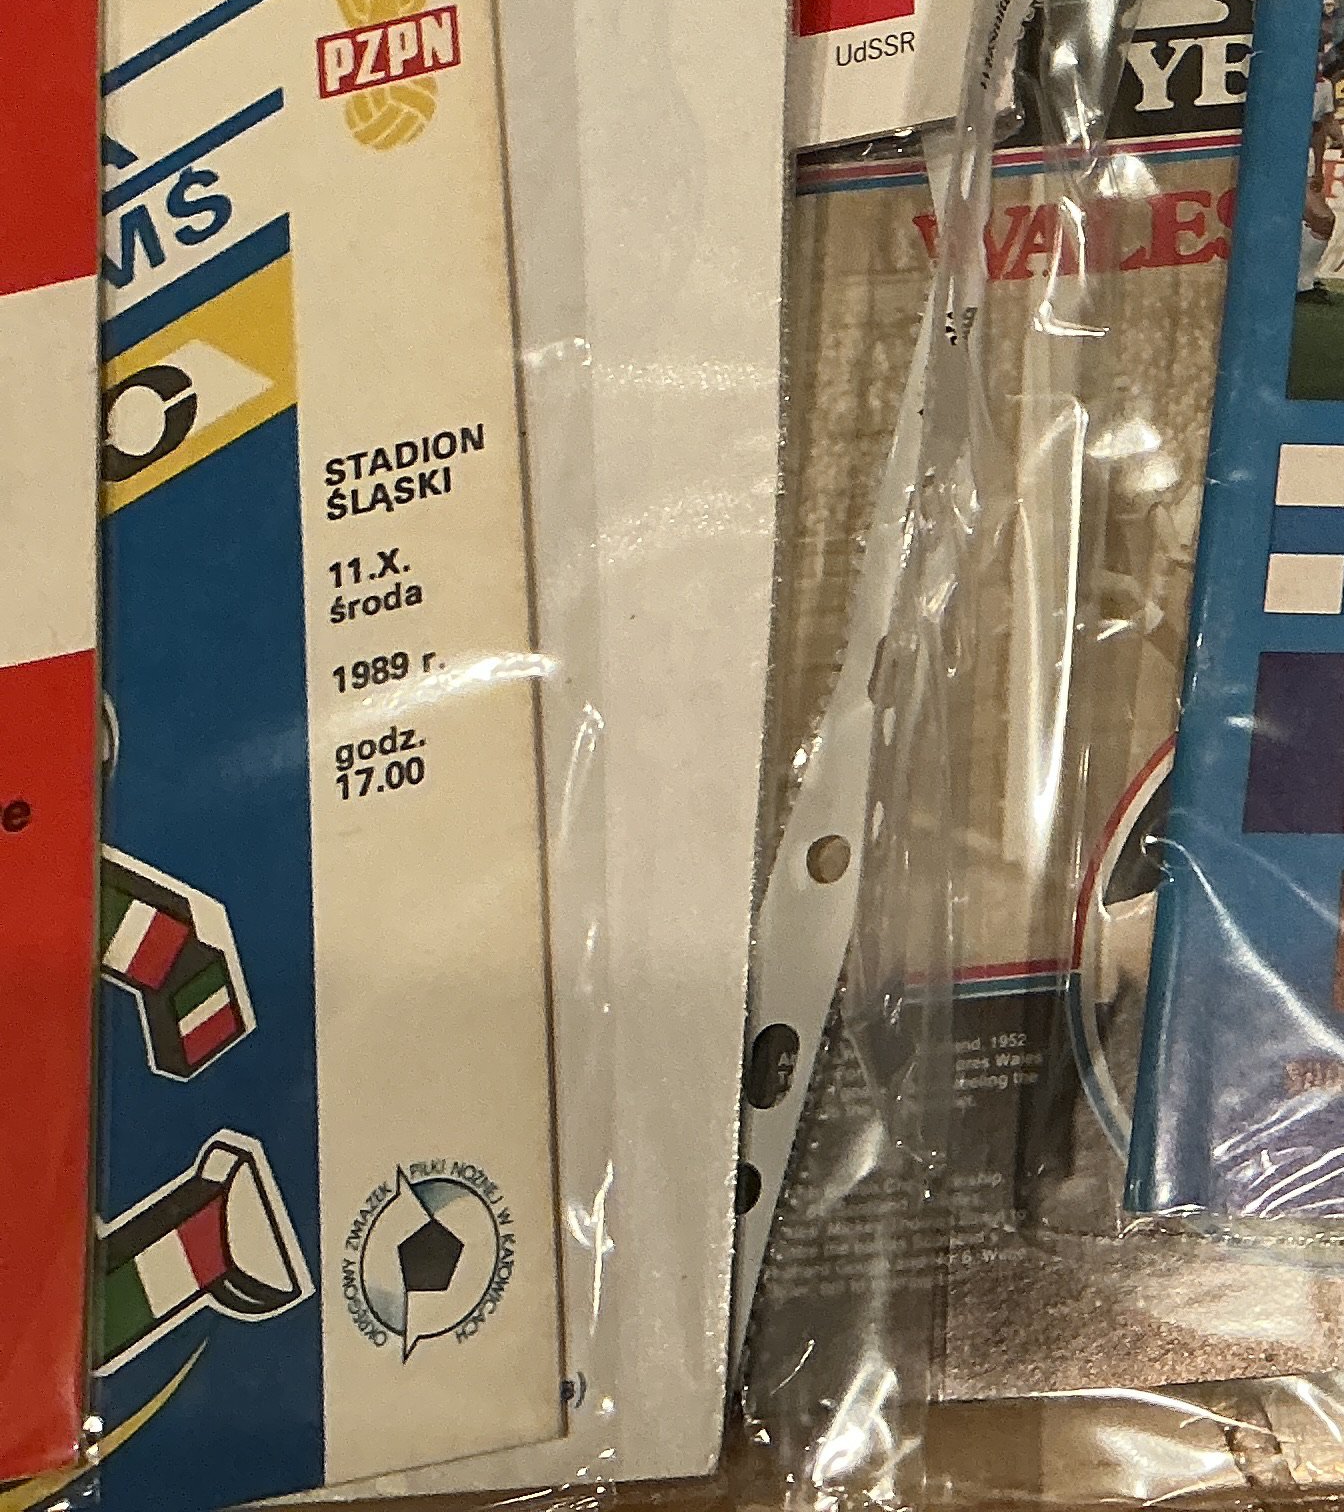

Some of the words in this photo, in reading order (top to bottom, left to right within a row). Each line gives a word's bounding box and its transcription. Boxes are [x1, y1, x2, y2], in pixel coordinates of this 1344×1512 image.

[325, 12, 456, 93] PZPN
[835, 31, 915, 66] UdSSR
[324, 423, 486, 487] STADION
[326, 466, 453, 521] ŚLĄSKI
[328, 547, 410, 589] 11.X.
[329, 582, 423, 624] środa
[332, 650, 409, 694] 1989
[421, 646, 447, 675] r.
[334, 725, 427, 773] godz.
[335, 756, 426, 801] 17.00
